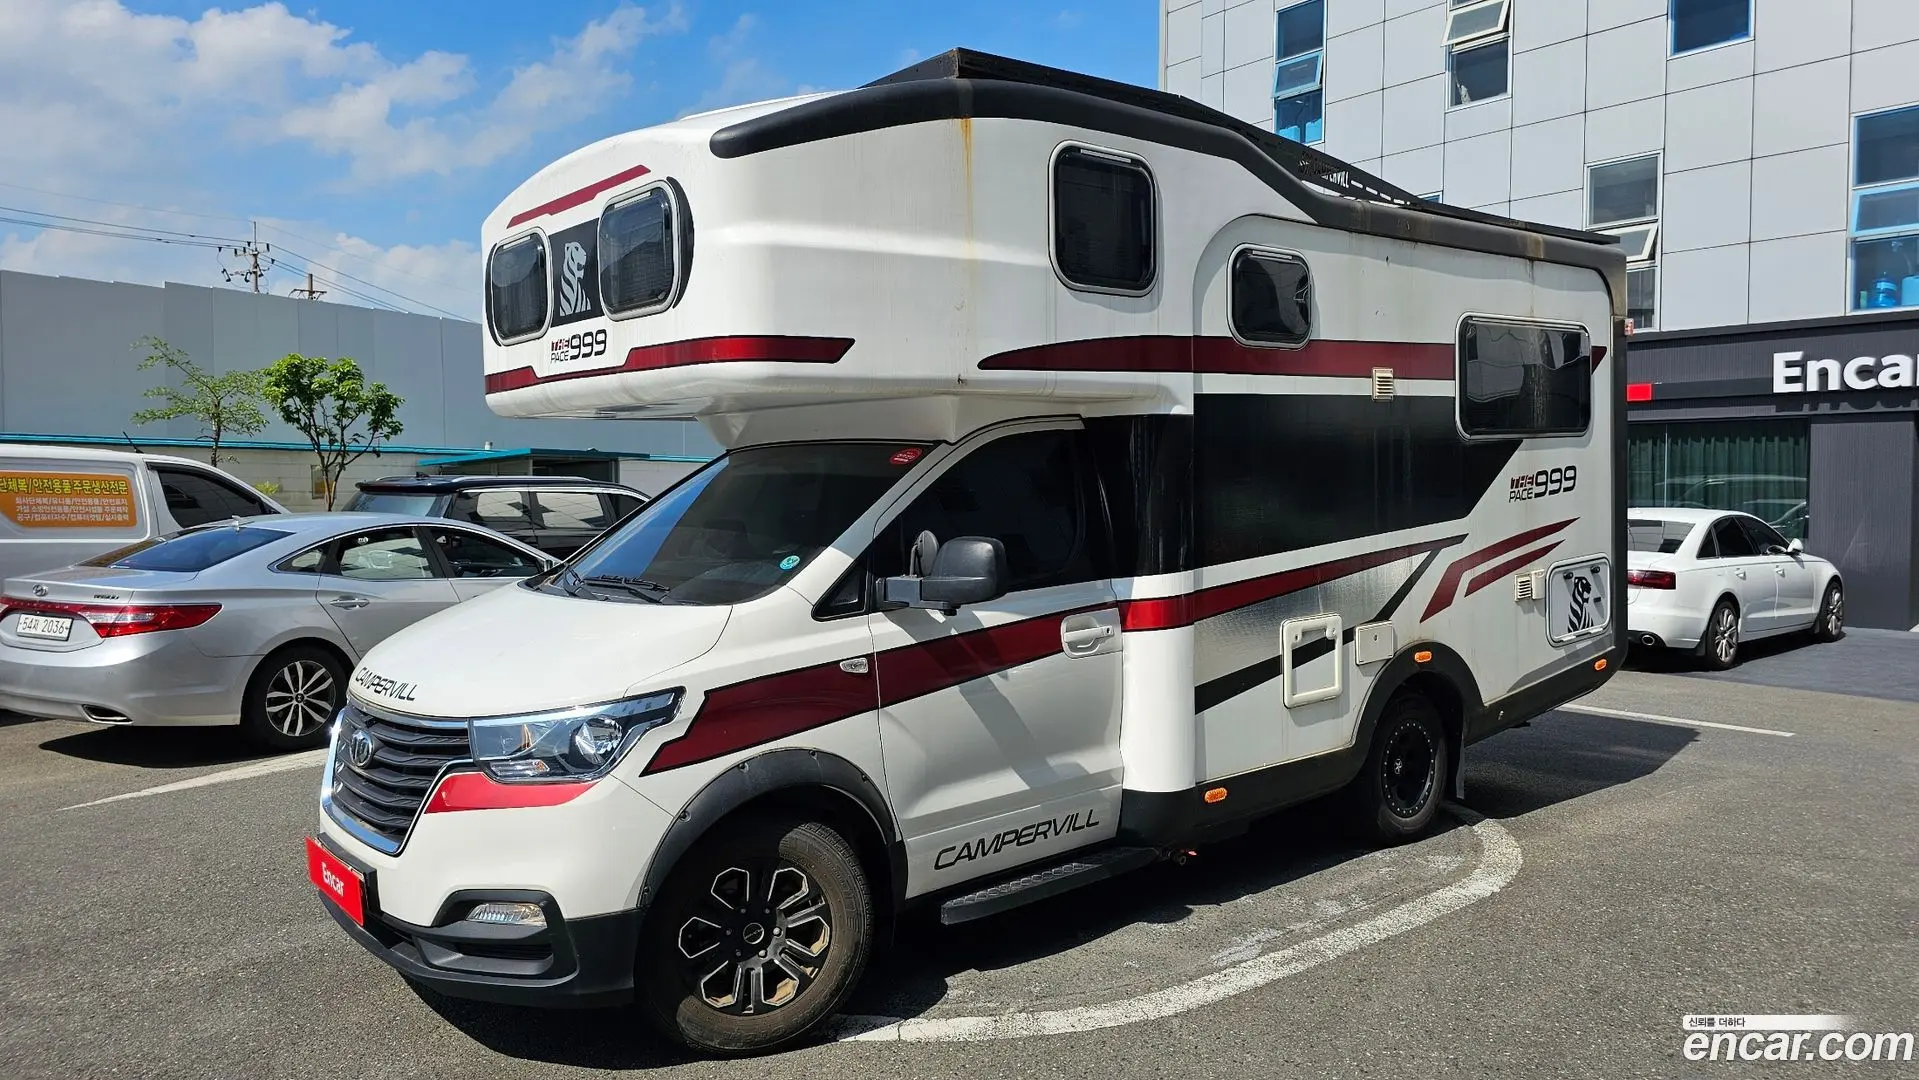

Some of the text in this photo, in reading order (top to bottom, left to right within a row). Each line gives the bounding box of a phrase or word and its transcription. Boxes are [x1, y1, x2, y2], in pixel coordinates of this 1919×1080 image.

[550, 350, 570, 364] PACE
[570, 328, 608, 361] 999
[1773, 350, 1919, 394] Enca
[1508, 487, 1534, 503] PACE
[1534, 465, 1577, 499] 999
[41, 619, 65, 634] 2036
[355, 666, 418, 702] CAMPERVILL
[933, 808, 1100, 871] CAMPERVILL
[321, 861, 345, 897] Encar
